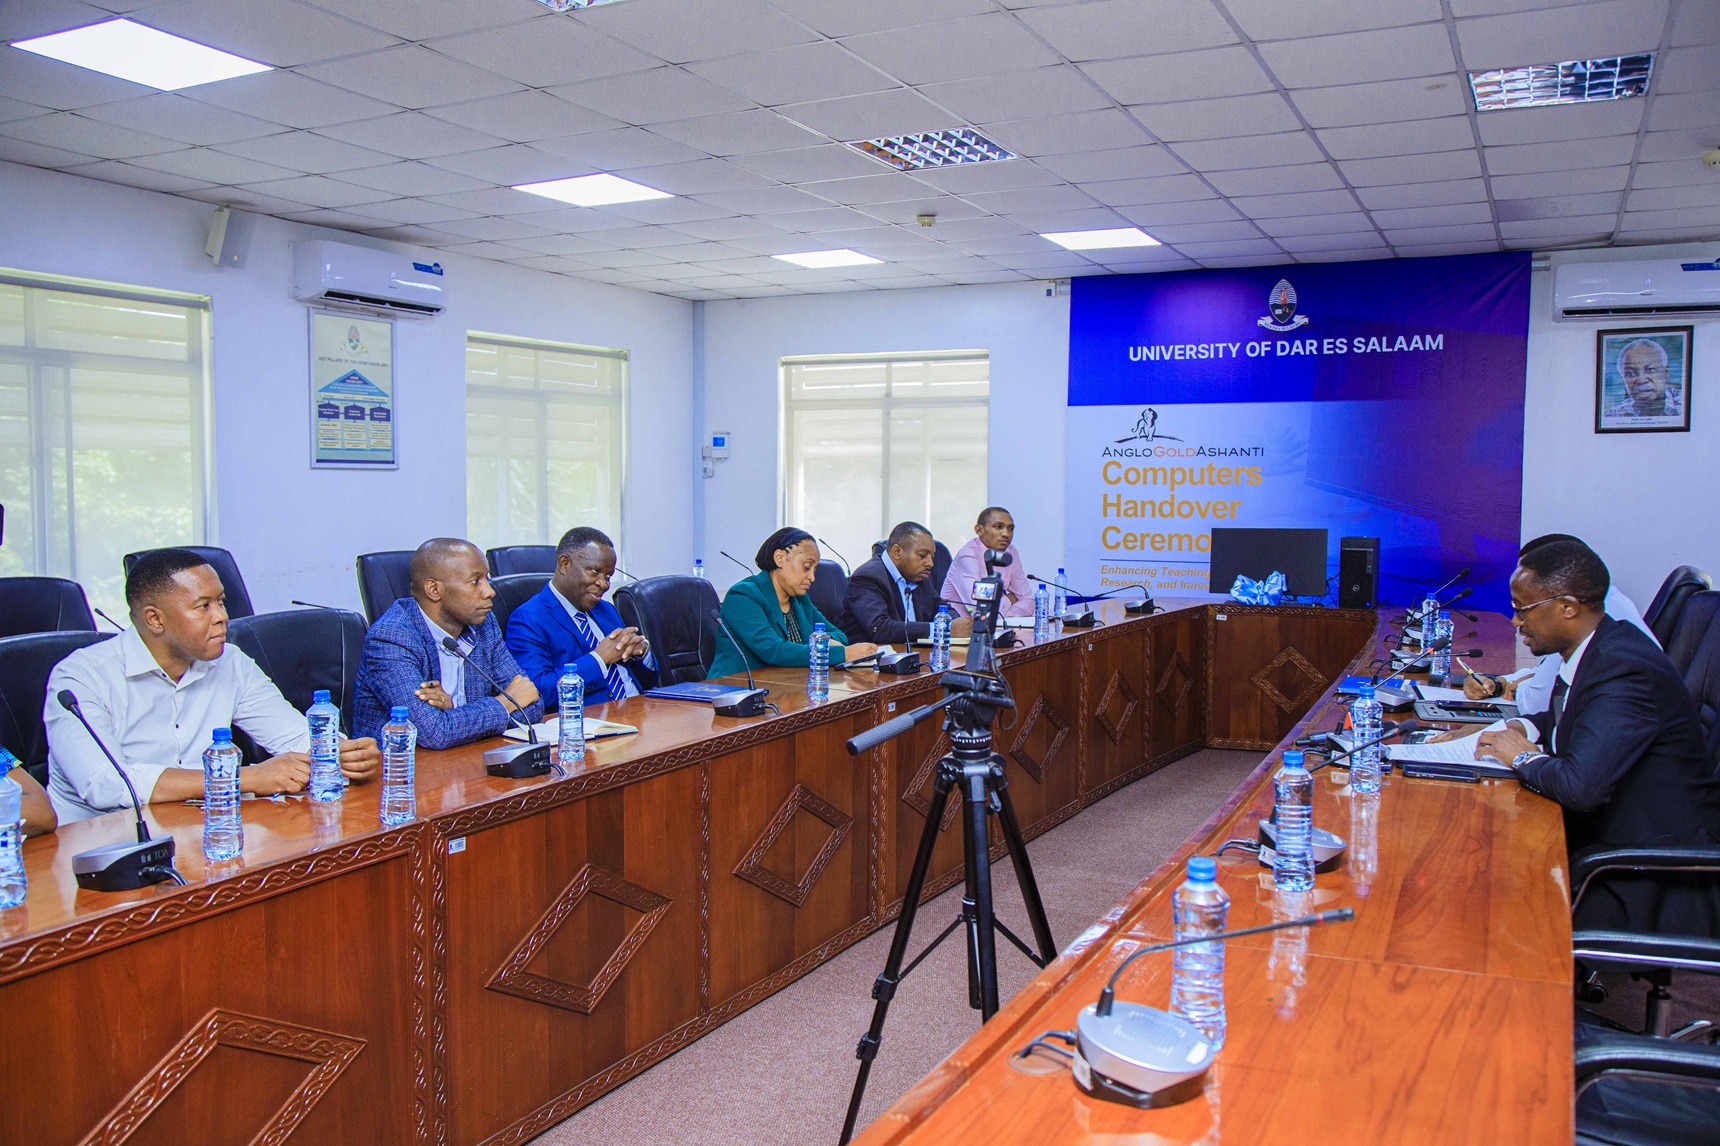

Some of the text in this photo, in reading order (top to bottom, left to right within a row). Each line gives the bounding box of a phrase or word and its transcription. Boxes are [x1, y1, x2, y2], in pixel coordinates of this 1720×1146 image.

[1129, 333, 1444, 362] UNIVERSITY OF DAR ES SALAAM
[1102, 460, 1263, 492] Computers
[1102, 493, 1242, 519] Handover
[1101, 525, 1212, 552] Ceremo
[1100, 565, 1210, 580] Enhancing Teaching
[1100, 577, 1153, 589] Research,
[1156, 580, 1178, 589] and
[153, 849, 169, 859] TOA
